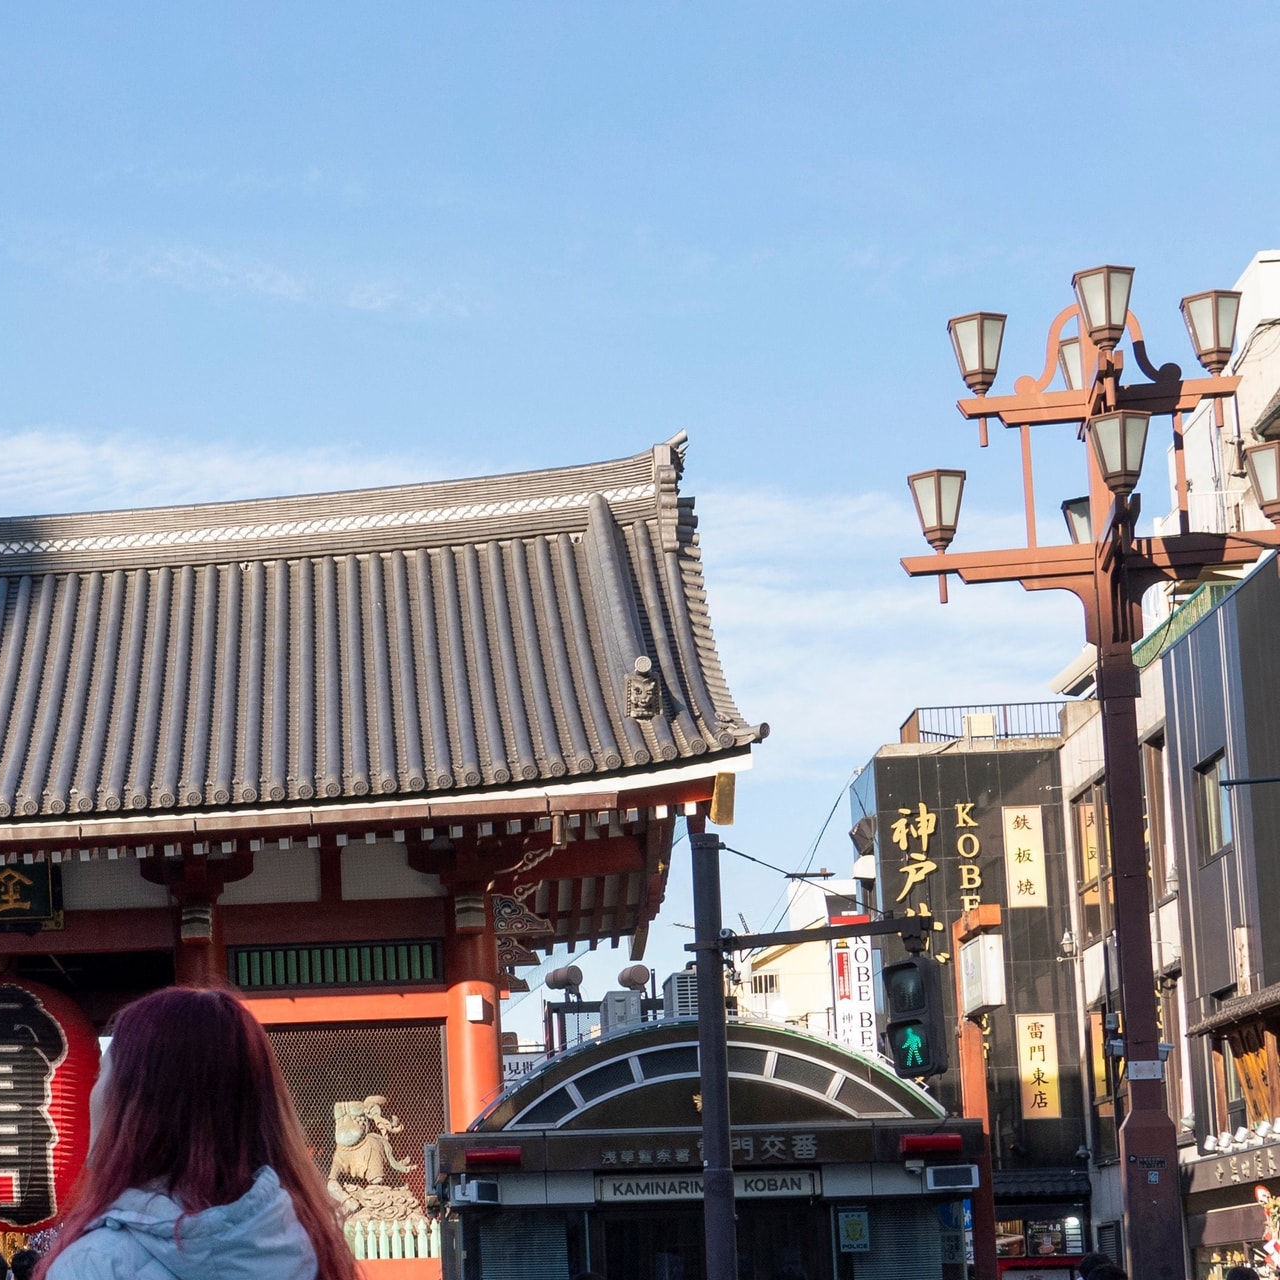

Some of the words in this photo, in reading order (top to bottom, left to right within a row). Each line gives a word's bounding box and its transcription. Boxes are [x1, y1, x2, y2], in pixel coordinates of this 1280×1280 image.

[1012, 815, 1036, 896] 鉄板焼
[860, 1011, 874, 1053] BE
[1028, 1021, 1048, 1109] 雷門東店
[697, 1133, 817, 1162] 門交番
[744, 1178, 801, 1193] KOBAN
[842, 1242, 869, 1250] POLICE
